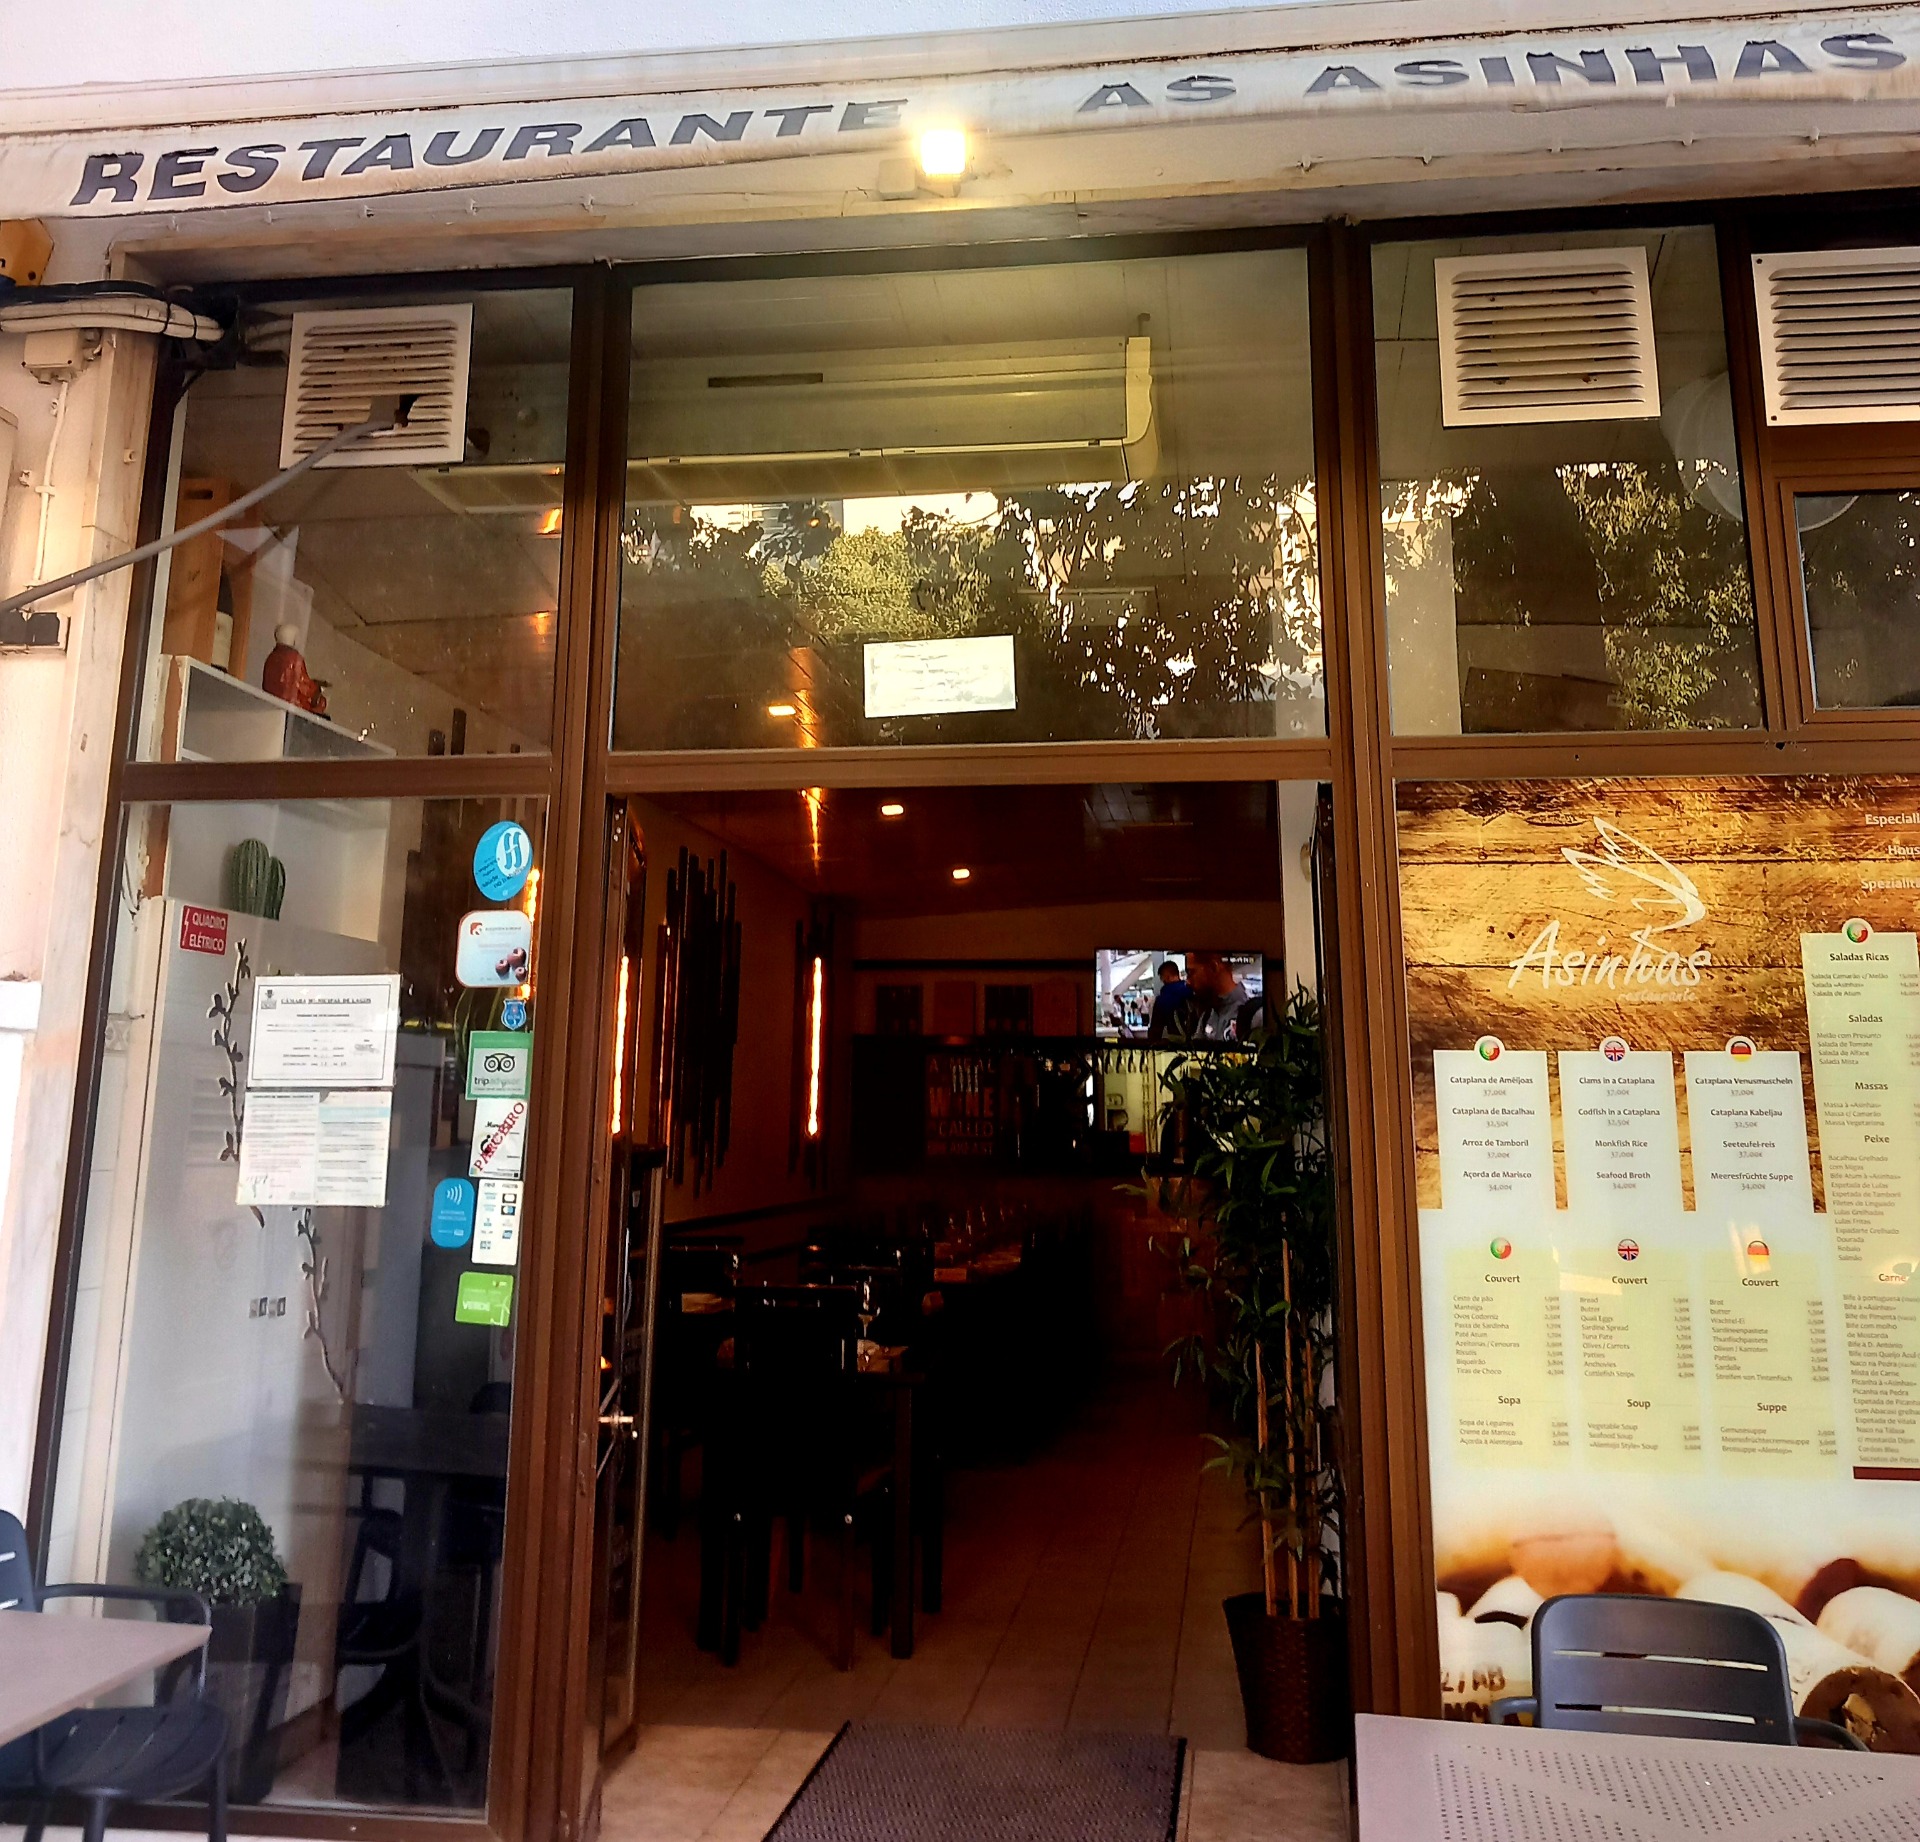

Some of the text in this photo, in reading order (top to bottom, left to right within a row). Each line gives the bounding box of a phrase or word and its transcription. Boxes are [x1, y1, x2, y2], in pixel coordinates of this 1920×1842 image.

[69, 33, 1907, 205] RESTAURANTE AS ASINHAS
[193, 912, 226, 930] QUADRO
[189, 932, 224, 951] ELÉTRICO
[1508, 920, 1712, 990] Asinhas
[1830, 953, 1889, 961] Saladas Ricas
[1849, 1014, 1883, 1023] Saladas
[1450, 1076, 1486, 1085] Cataplana
[1488, 1076, 1498, 1084] de
[1618, 1077, 1655, 1085] Cataplana
[1695, 1078, 1732, 1086] Cataplana
[1855, 1082, 1888, 1090] Massas
[1452, 1108, 1489, 1116] Cataplana
[1578, 1108, 1606, 1116] Codfish
[1623, 1109, 1660, 1117] Cataplana
[1710, 1109, 1783, 1117] Cataplana Kabeljau
[474, 1102, 525, 1172] PARCEIRO
[1864, 1134, 1890, 1143] Peixe
[1463, 1171, 1489, 1179] Açorda
[1711, 1172, 1793, 1182] Meeresfrüchte Suppe
[1485, 1274, 1520, 1283] Couvert
[1612, 1276, 1648, 1284] Couvert
[1742, 1278, 1779, 1287] Couvert
[1498, 1395, 1521, 1406] Sopa
[1627, 1399, 1651, 1409] Soup
[1757, 1402, 1787, 1413] Suppe
